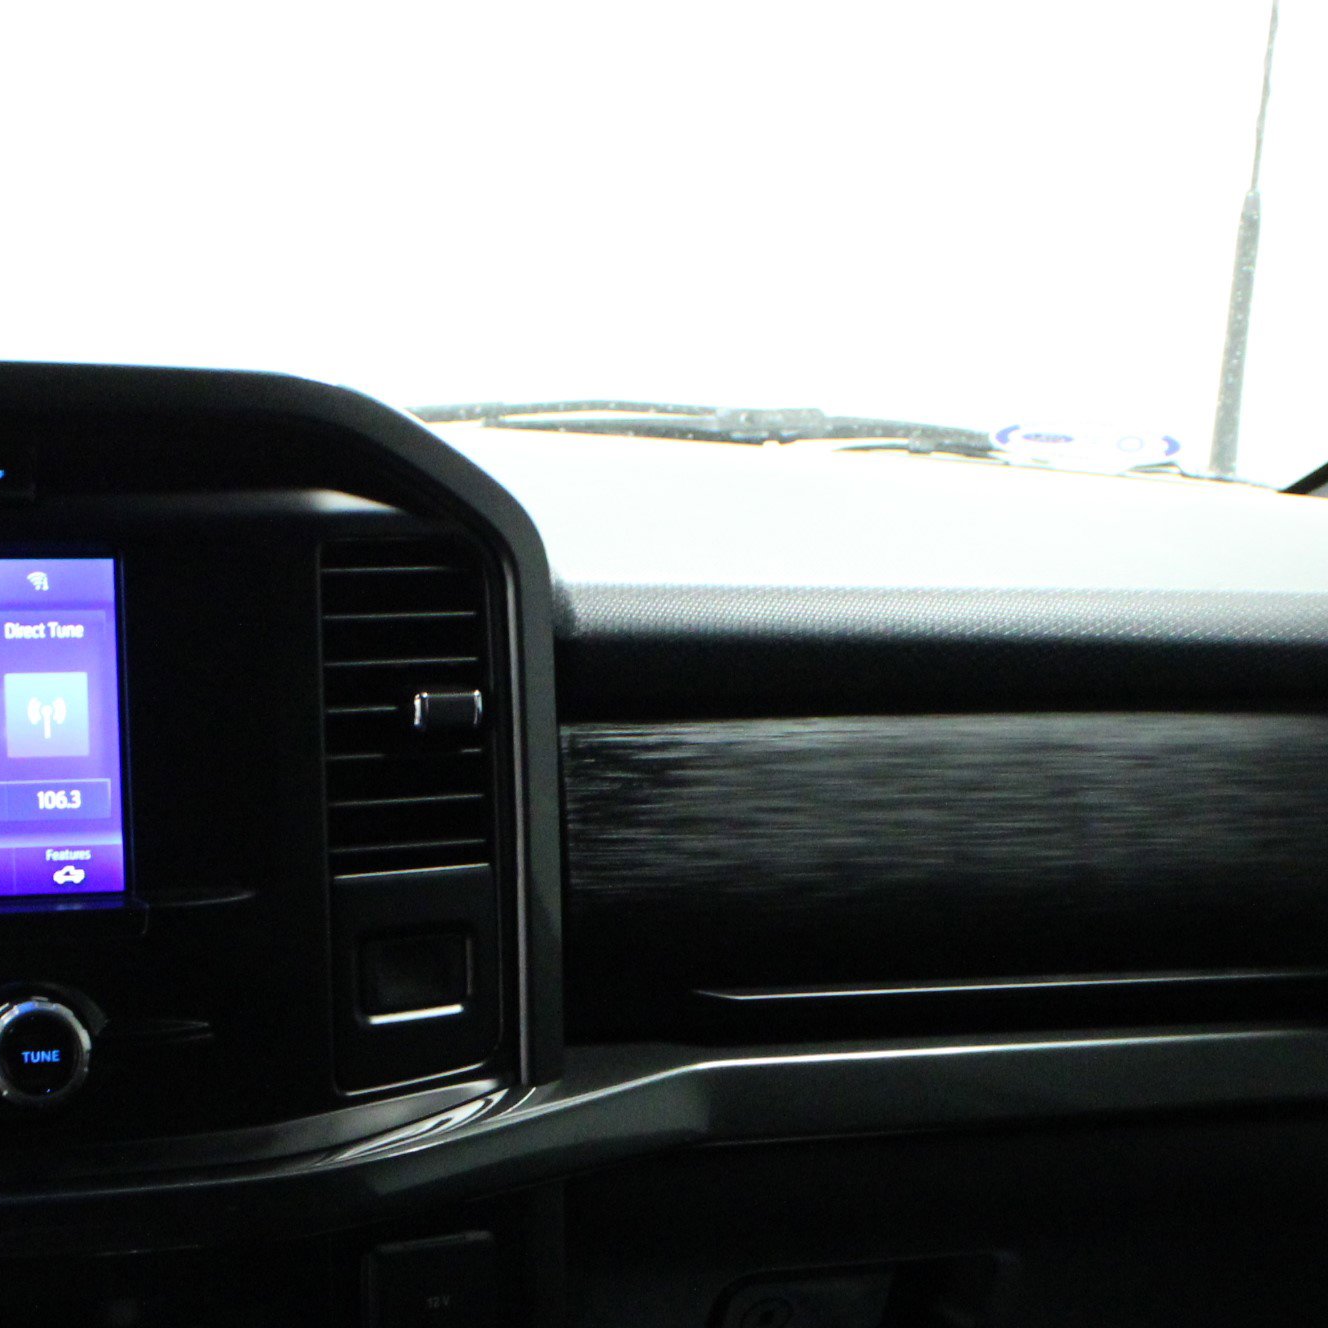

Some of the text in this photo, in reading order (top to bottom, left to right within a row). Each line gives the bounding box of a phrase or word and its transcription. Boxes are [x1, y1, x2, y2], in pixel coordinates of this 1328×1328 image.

[4, 621, 84, 640] Direct Tune
[37, 789, 82, 810] 106.3
[45, 847, 92, 862] Features
[21, 1050, 60, 1064] TUNE
